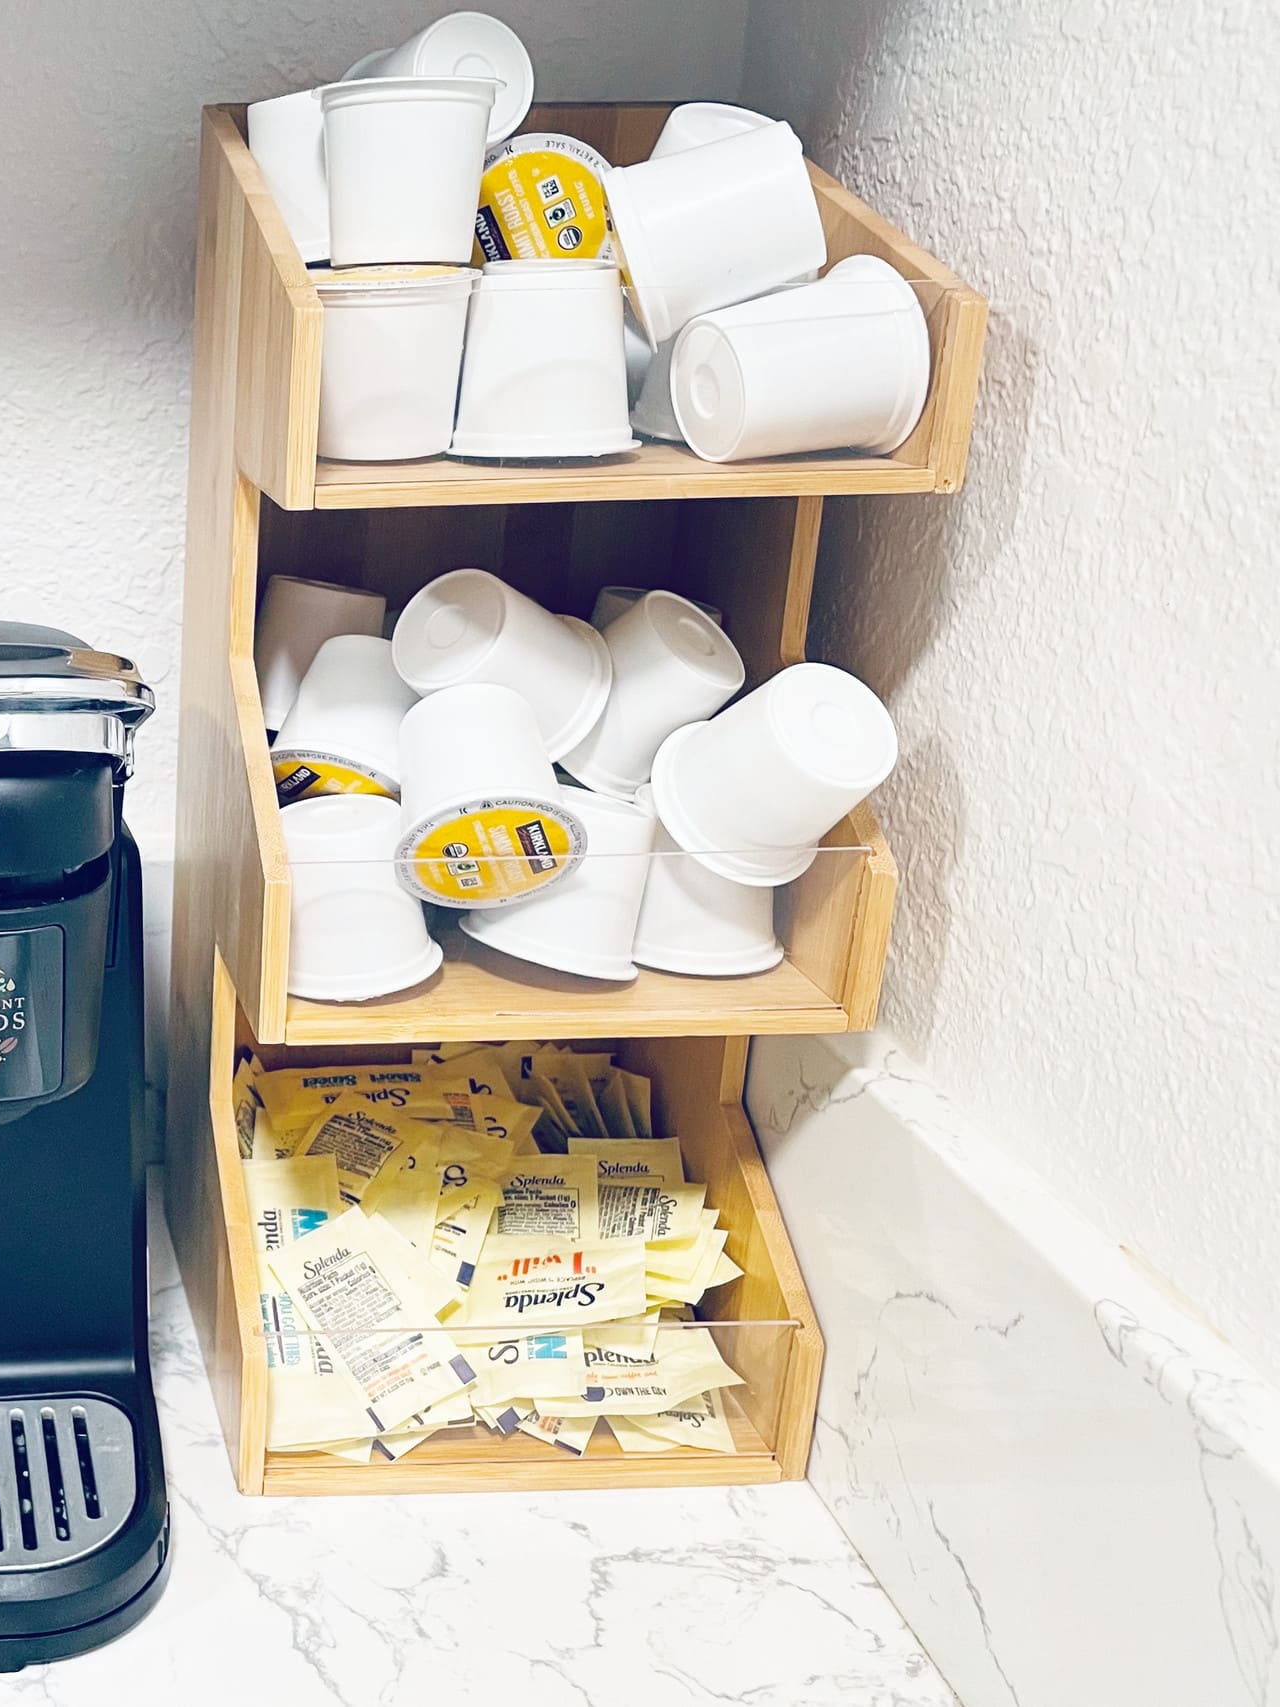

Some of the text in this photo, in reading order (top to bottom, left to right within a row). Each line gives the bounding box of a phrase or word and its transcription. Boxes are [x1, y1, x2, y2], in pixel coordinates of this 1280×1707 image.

[546, 140, 566, 150] SALE
[495, 188, 525, 231] ROAST
[599, 1160, 650, 1175] Splenda
[510, 1174, 566, 1188] Splenda
[658, 1195, 678, 1236] Splenda
[304, 1248, 352, 1280] Splenda
[506, 1282, 604, 1312] Splenda
[615, 1388, 634, 1396] OWN
[634, 1387, 651, 1396] THE
